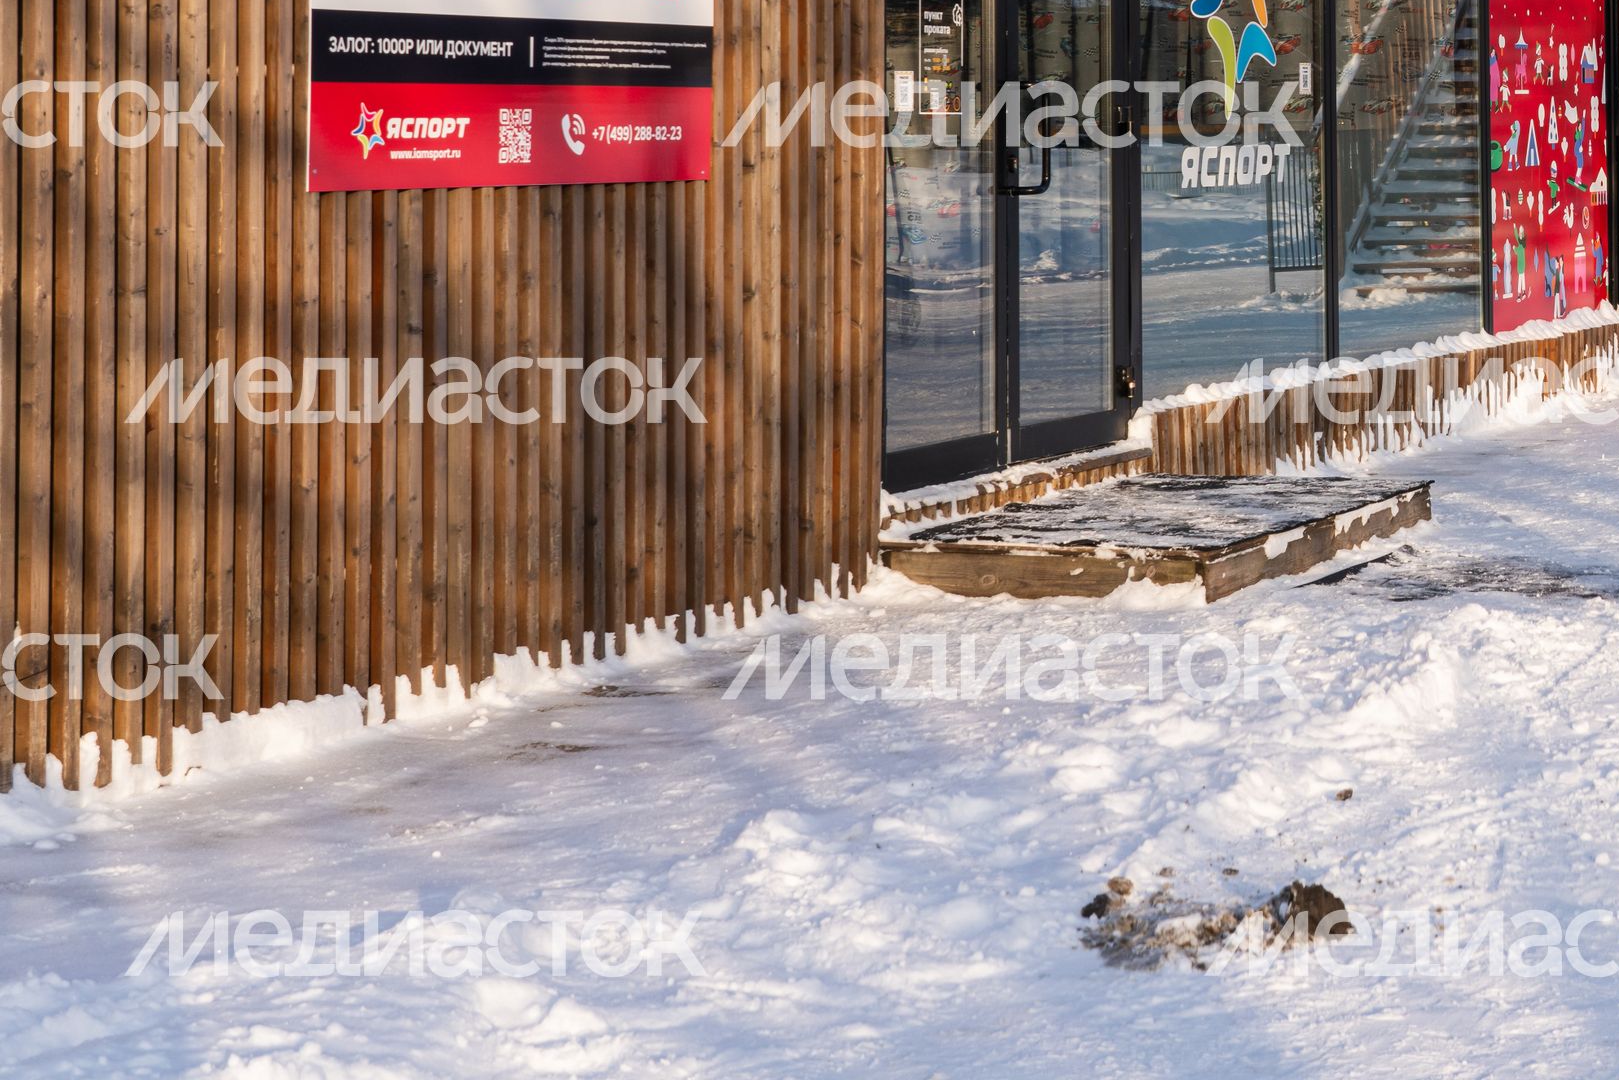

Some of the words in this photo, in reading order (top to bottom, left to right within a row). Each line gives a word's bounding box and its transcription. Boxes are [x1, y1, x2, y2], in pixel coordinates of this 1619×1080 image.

[329, 36, 375, 53] ЗАЛОГ:
[416, 39, 443, 55] ИЛИ
[445, 40, 514, 59] ДОКУМЕНТ
[386, 117, 470, 139] ЯСПОРТ
[592, 126, 605, 141] +7
[606, 124, 633, 144] (499)
[634, 126, 682, 141] 288-82-23
[1181, 143, 1290, 189] ЯСПОРТ
